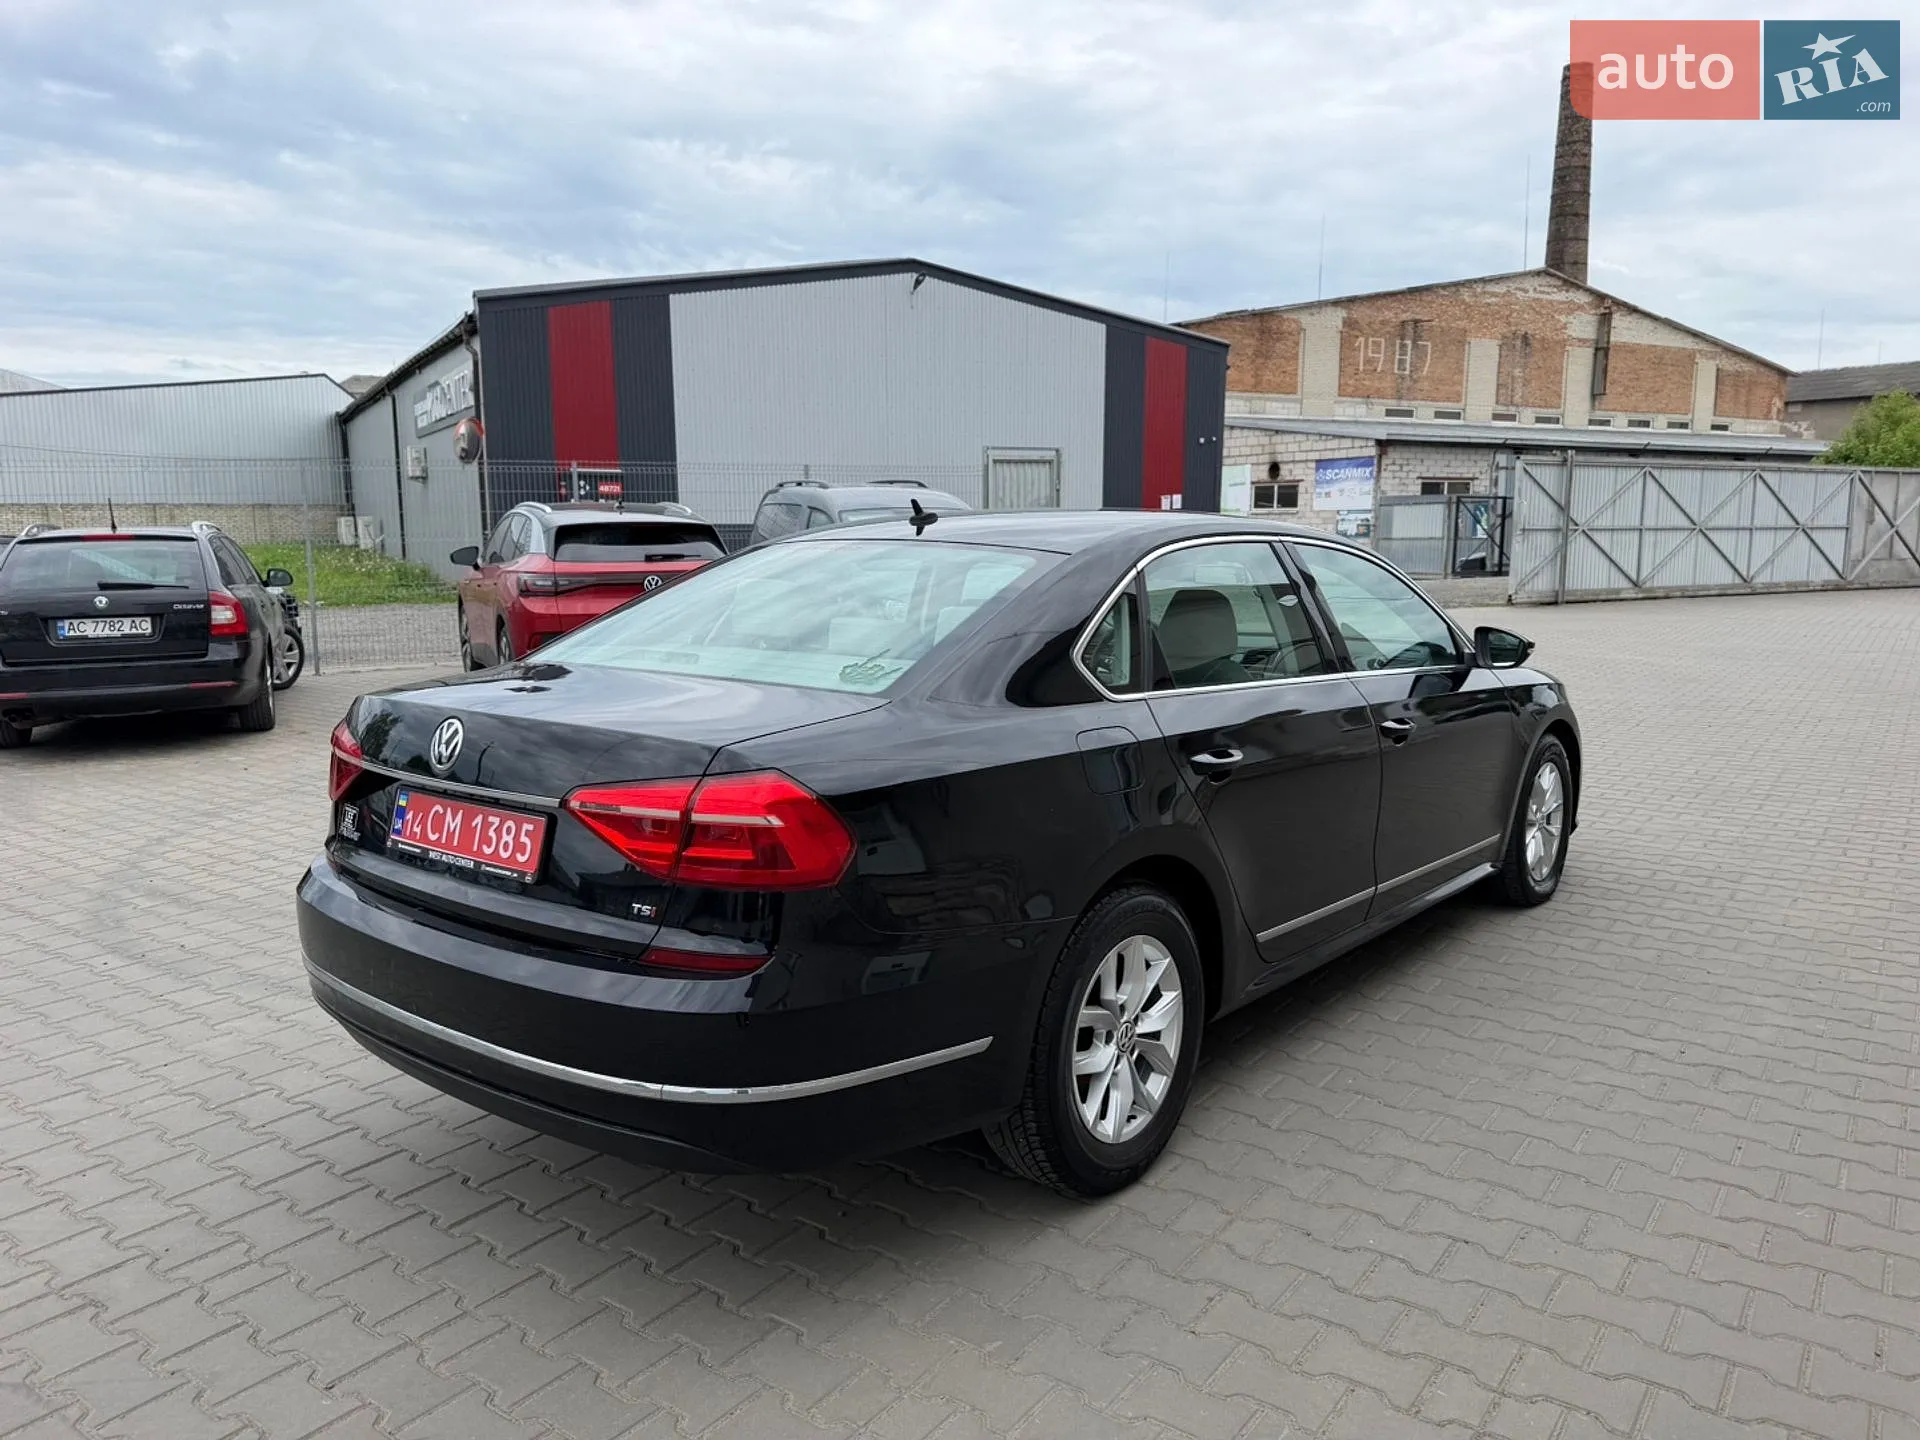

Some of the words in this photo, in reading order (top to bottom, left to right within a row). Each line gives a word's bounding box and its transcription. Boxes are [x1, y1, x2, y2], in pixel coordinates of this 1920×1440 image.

[1355, 336, 1431, 375] 1987
[1325, 467, 1373, 481] SCANMIX
[67, 621, 87, 634] AC
[92, 620, 125, 633] 7782
[129, 619, 149, 632] AC
[472, 813, 534, 863] 1385
